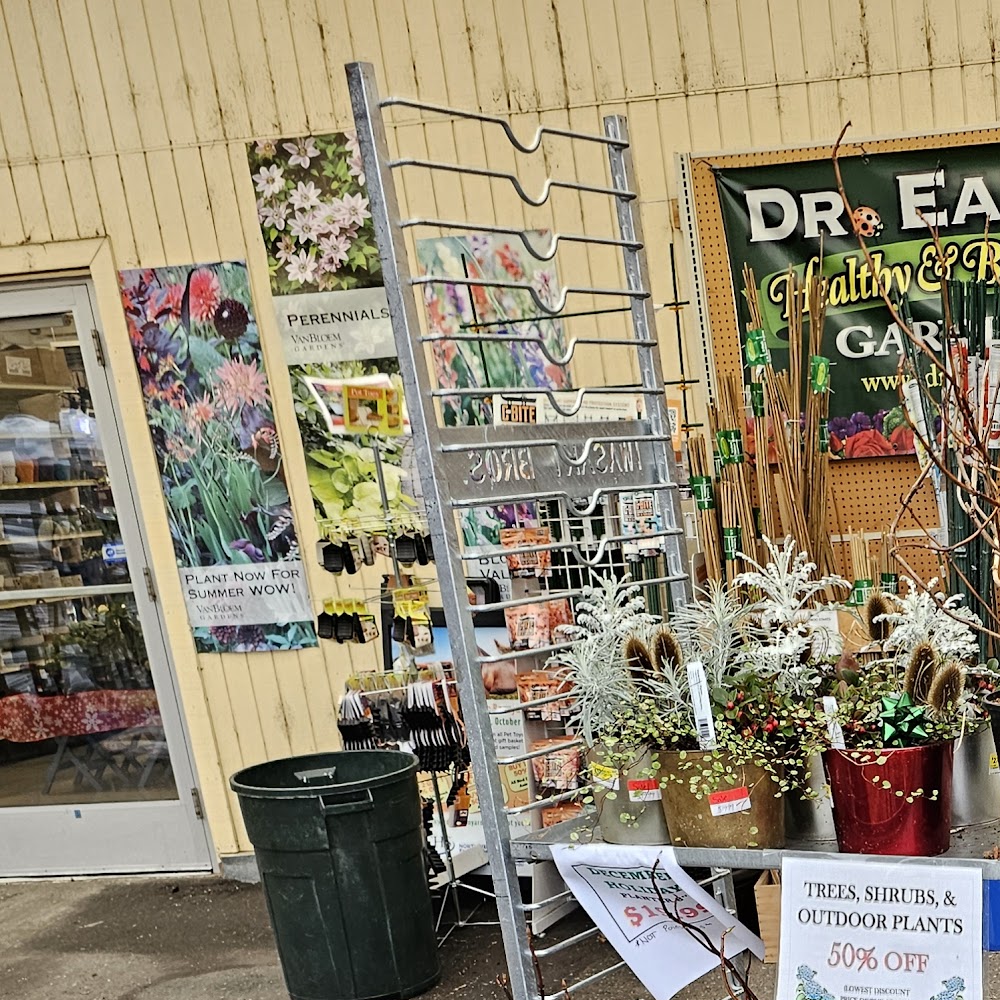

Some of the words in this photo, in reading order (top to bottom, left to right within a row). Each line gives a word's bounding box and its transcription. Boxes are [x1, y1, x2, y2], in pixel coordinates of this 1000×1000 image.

[769, 252, 913, 317] Healthy
[917, 245, 961, 292] &
[287, 307, 389, 327] PERENNIALS
[294, 342, 345, 353] GARDENS
[185, 573, 228, 585] PLANT
[234, 571, 265, 582] NOW
[271, 568, 300, 580] FOR
[188, 588, 244, 600] SUMMER
[249, 583, 296, 597] WOW!
[495, 717, 521, 726] October
[804, 881, 860, 904] TREES,
[864, 885, 939, 909] SHRUBS,
[943, 890, 958, 906] &
[798, 908, 887, 930] OUTDOOR
[892, 915, 963, 935] PLANTS
[827, 941, 878, 972] 50%
[884, 951, 930, 973] OFF
[874, 987, 911, 997] DISCOUNT
